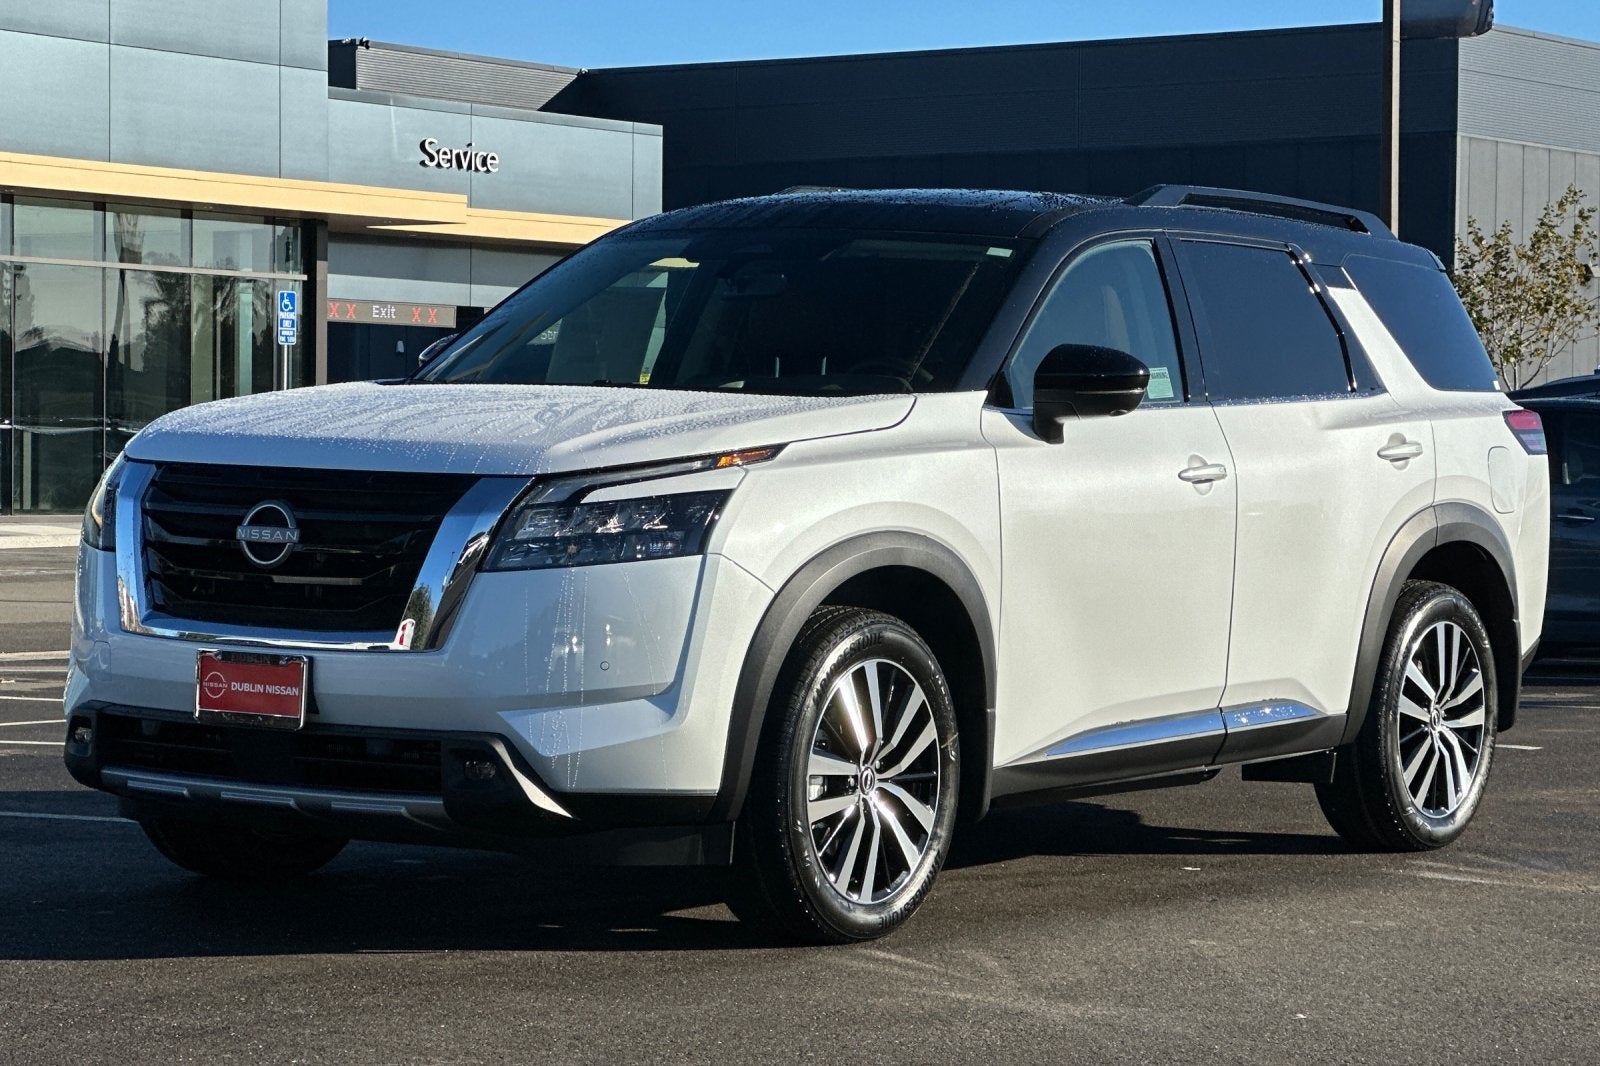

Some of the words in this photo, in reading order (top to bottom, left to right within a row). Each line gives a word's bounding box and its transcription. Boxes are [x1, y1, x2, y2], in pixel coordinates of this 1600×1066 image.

[419, 137, 499, 174] Service
[372, 304, 397, 319] Exit
[237, 527, 298, 541] NISSAN
[231, 682, 264, 693] DUBLIN
[265, 685, 299, 697] NISSAN
